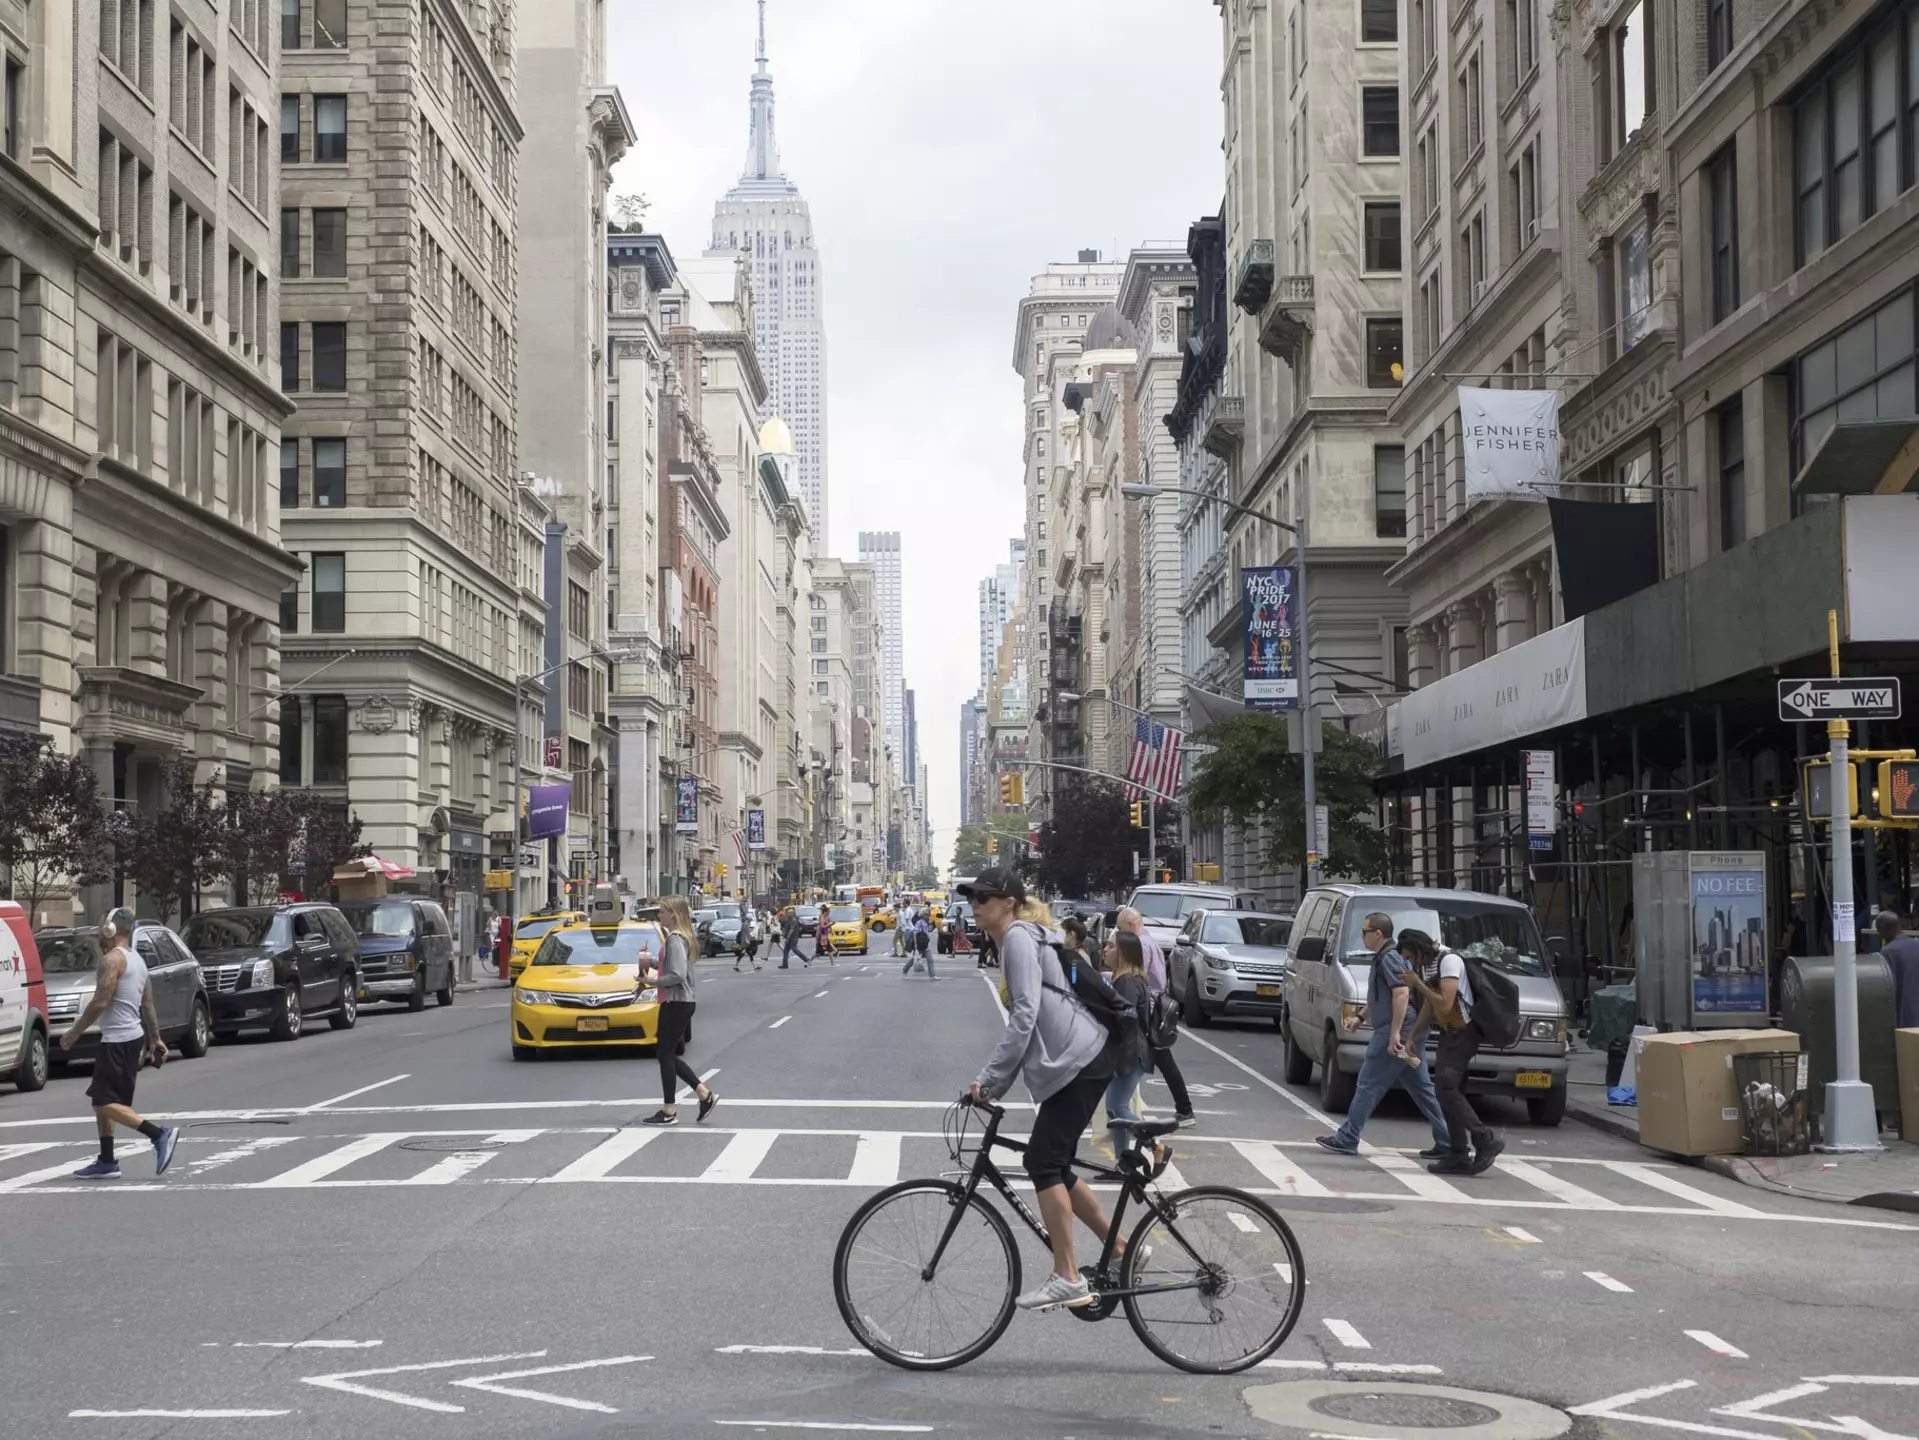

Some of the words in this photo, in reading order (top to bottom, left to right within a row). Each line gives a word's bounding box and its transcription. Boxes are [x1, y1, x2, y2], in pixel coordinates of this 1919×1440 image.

[1465, 425, 1559, 441] JENNIFER
[1476, 439, 1546, 453] FISHER
[1247, 575, 1272, 588] NYC
[1250, 585, 1285, 595] PRIDE
[1263, 594, 1290, 604] 2017
[1248, 620, 1277, 631] JUNE
[1414, 718, 1431, 737] ZARA
[1452, 702, 1474, 722] ZARA
[1494, 686, 1520, 708] ZARA
[1542, 664, 1570, 691] ZARA
[1792, 692, 1831, 708] ONE
[1851, 690, 1888, 707] WAY
[1710, 856, 1744, 865] Phone
[1697, 877, 1723, 892] NO
[1726, 877, 1756, 892] FEE
